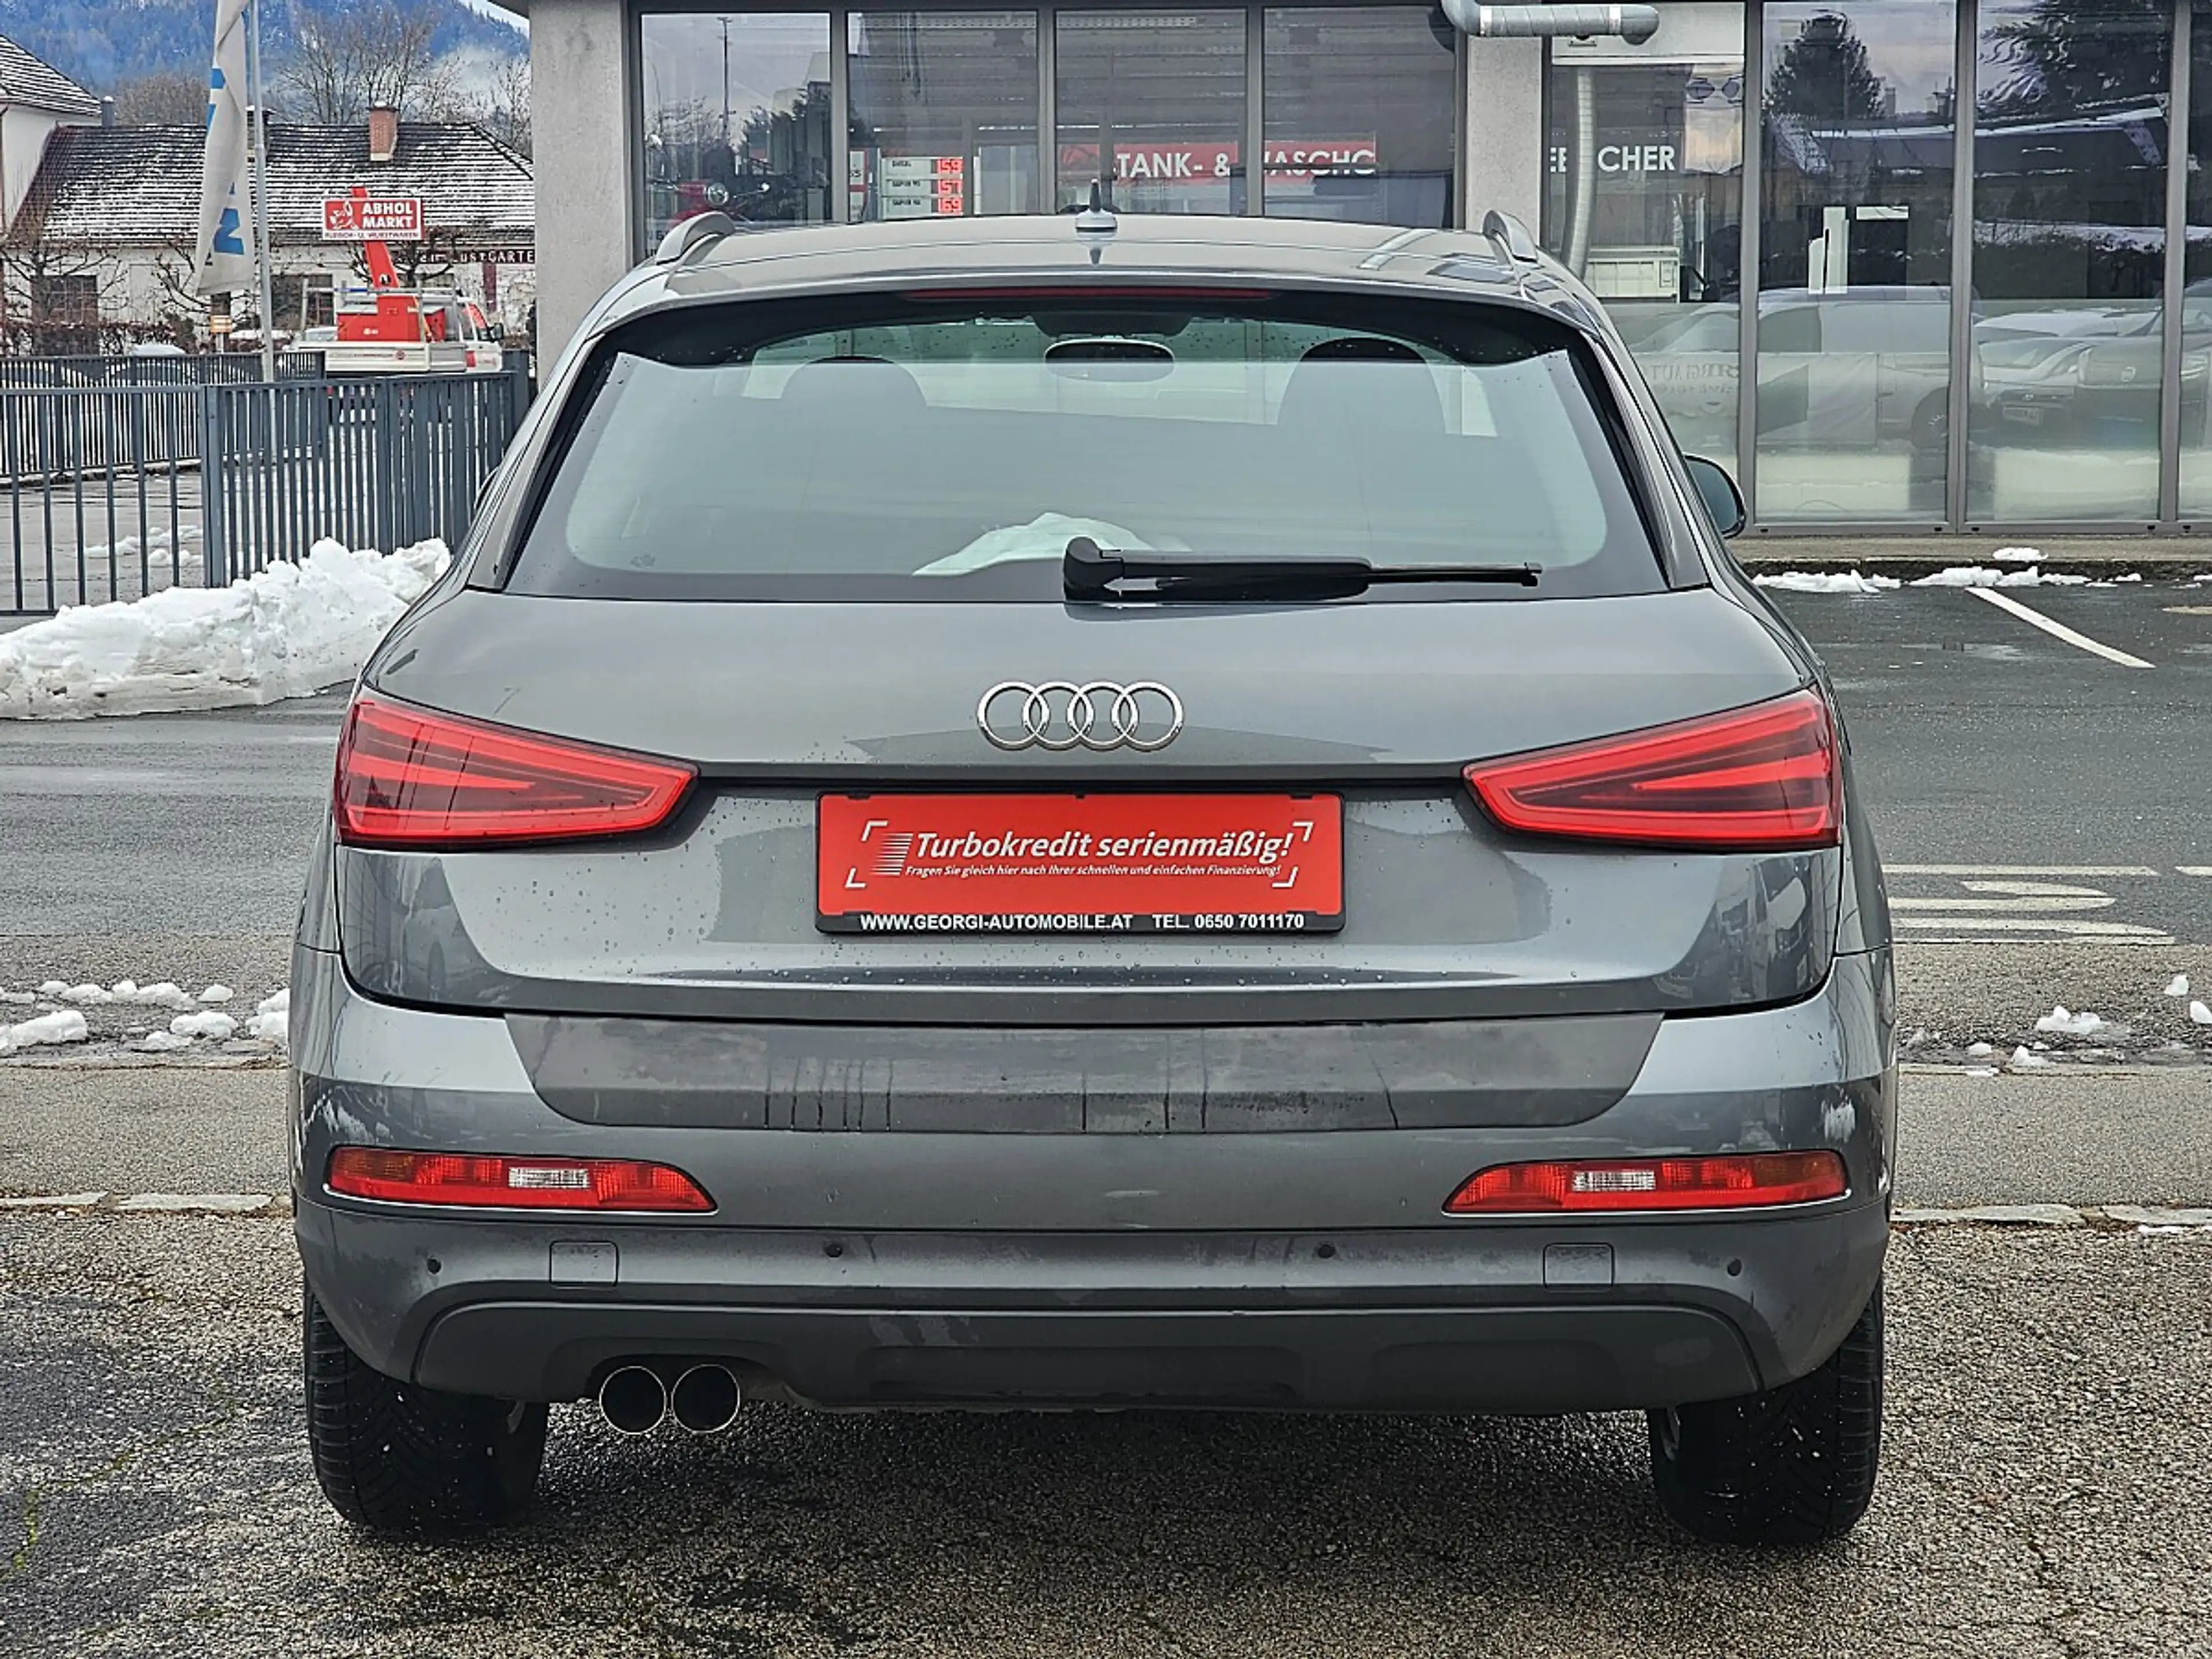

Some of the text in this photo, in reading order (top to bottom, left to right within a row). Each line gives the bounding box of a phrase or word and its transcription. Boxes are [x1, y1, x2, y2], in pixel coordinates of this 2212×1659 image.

[362, 203, 413, 215] ABHOL
[363, 215, 413, 229] MARKT
[918, 831, 1294, 864] Turbokredit serienmäßig!
[905, 866, 942, 878] Fragen
[944, 865, 961, 875] Sie
[961, 865, 995, 878] gleich
[997, 865, 1019, 875] hier
[1021, 865, 1046, 875] nach
[1076, 865, 1128, 875] schnellen
[1130, 865, 1153, 875] und
[1153, 865, 1205, 875] einfachen
[1207, 865, 1282, 878] Finanzierung!
[860, 914, 1304, 930] WWW.GEORGI-AUTOMOBILE.AT TEL. 0650 7011170
